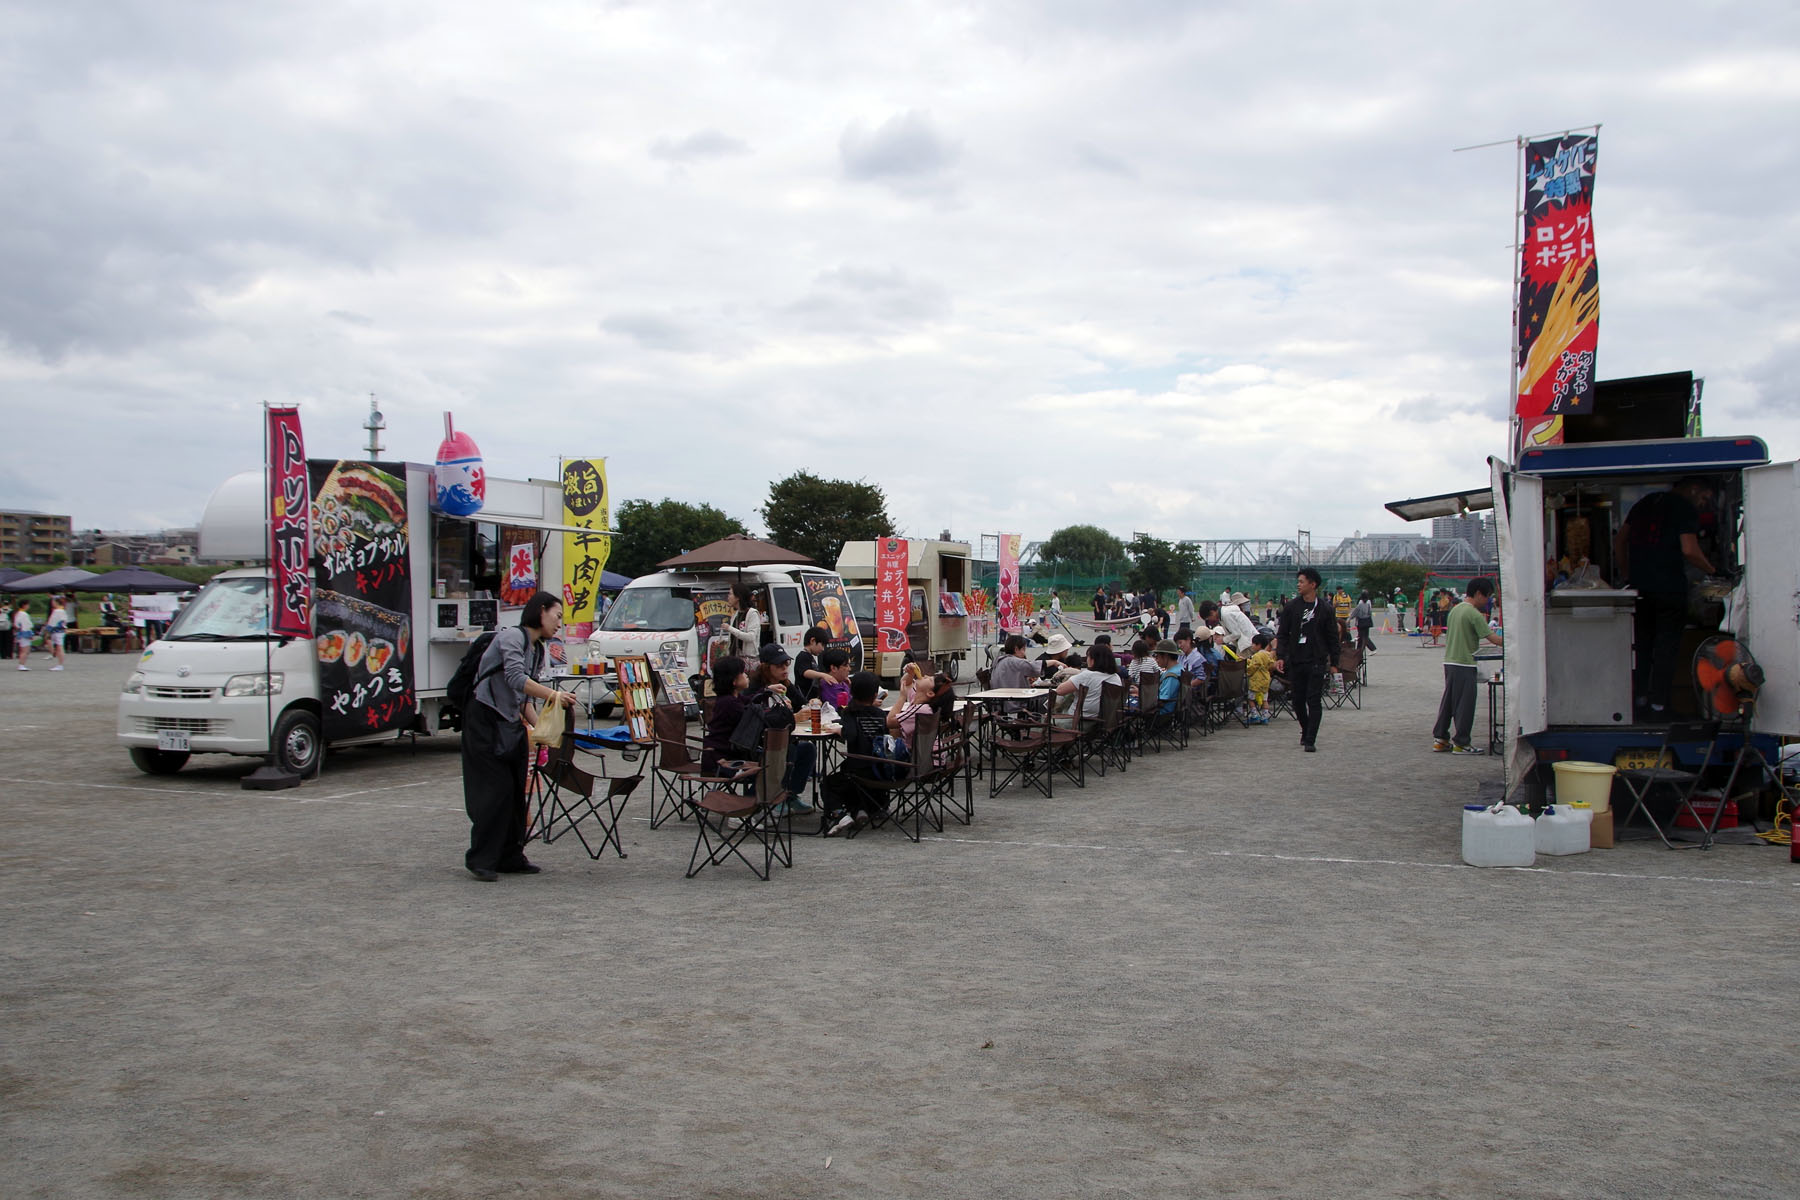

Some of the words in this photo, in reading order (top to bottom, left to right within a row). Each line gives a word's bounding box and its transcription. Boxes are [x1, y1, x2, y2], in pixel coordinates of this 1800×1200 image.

[1537, 212, 1590, 242] ロング
[1536, 238, 1593, 267] ポテト
[323, 533, 406, 580] サムギョプサル
[511, 549, 532, 578] 氷
[572, 519, 601, 619] 羊肉串
[881, 570, 895, 623] お弁当
[895, 569, 906, 626] テイクアウト
[330, 667, 404, 715] やみつき
